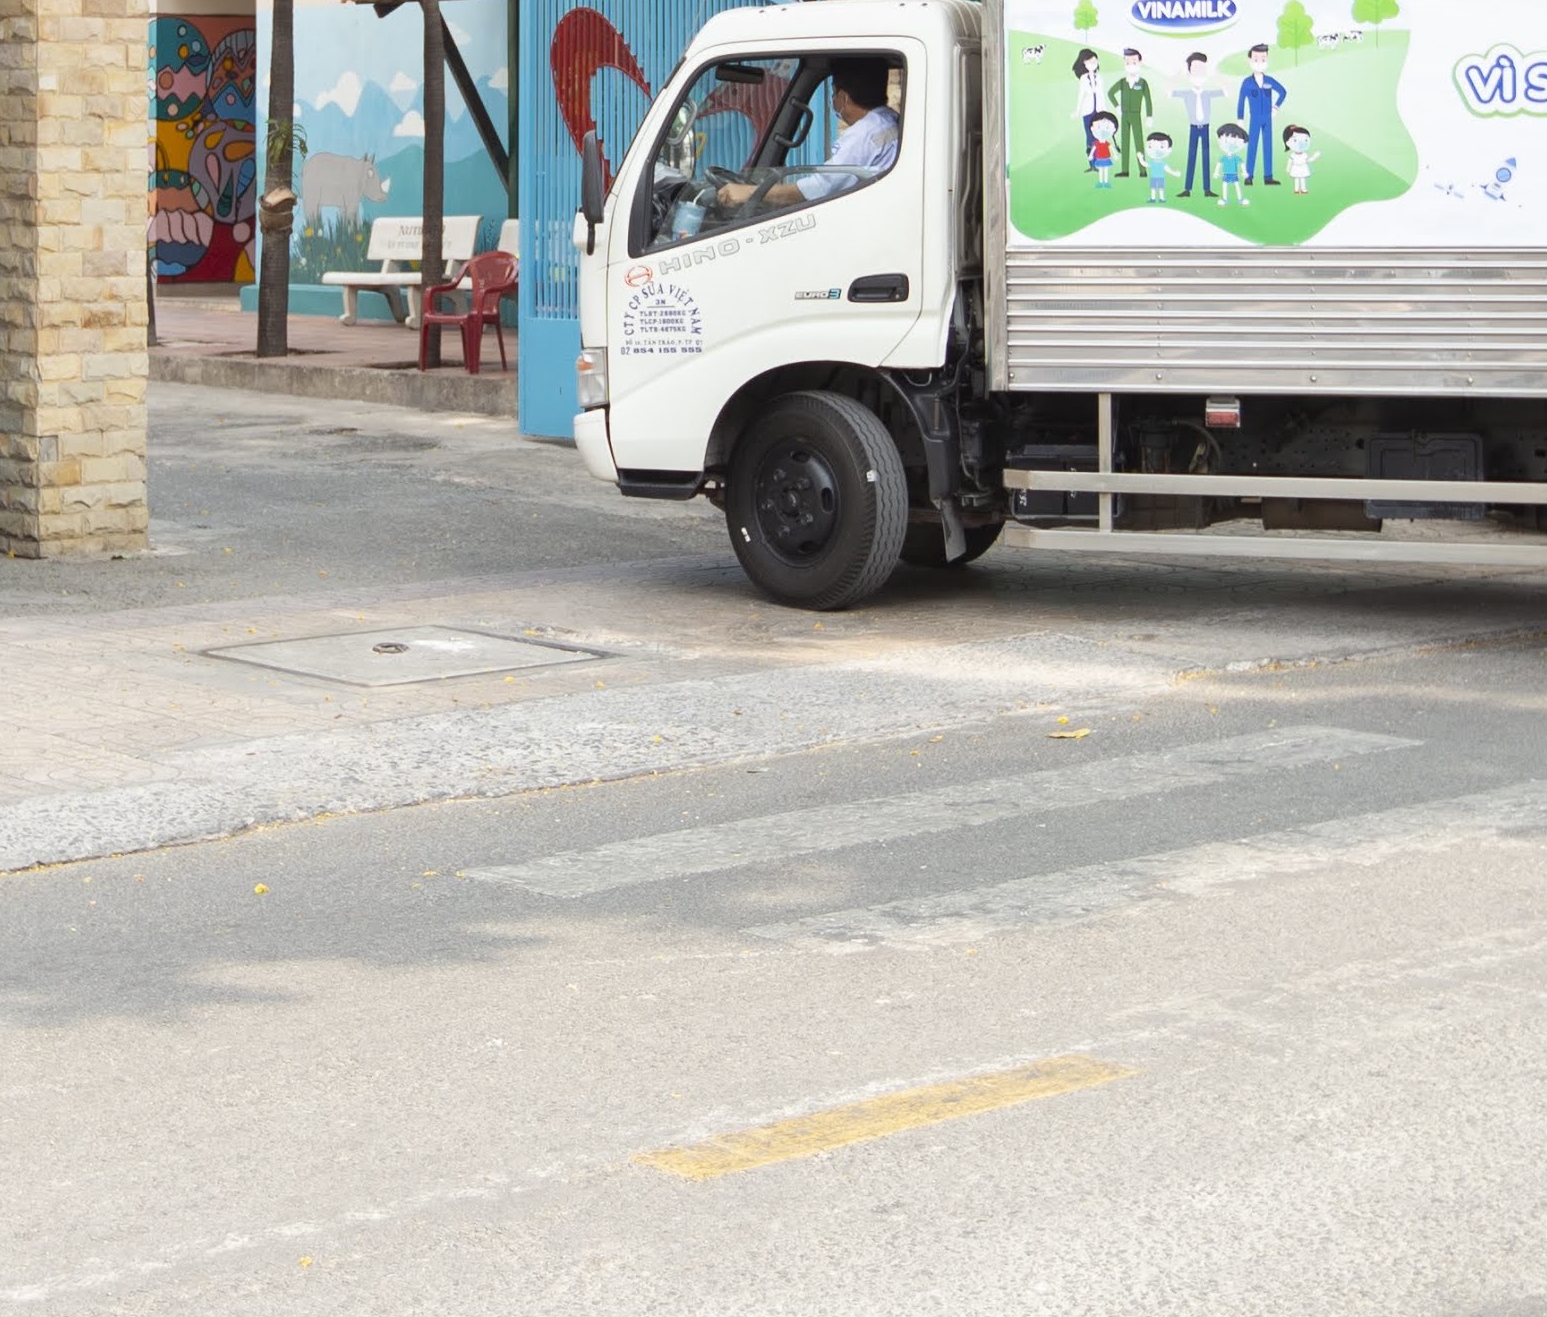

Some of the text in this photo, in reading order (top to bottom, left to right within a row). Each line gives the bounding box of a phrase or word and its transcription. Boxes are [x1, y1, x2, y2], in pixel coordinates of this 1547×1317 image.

[1137, 0, 1233, 20] VINAMILK
[1464, 54, 1518, 104] VÌ
[659, 240, 742, 277] HINO
[758, 214, 817, 245] XZU
